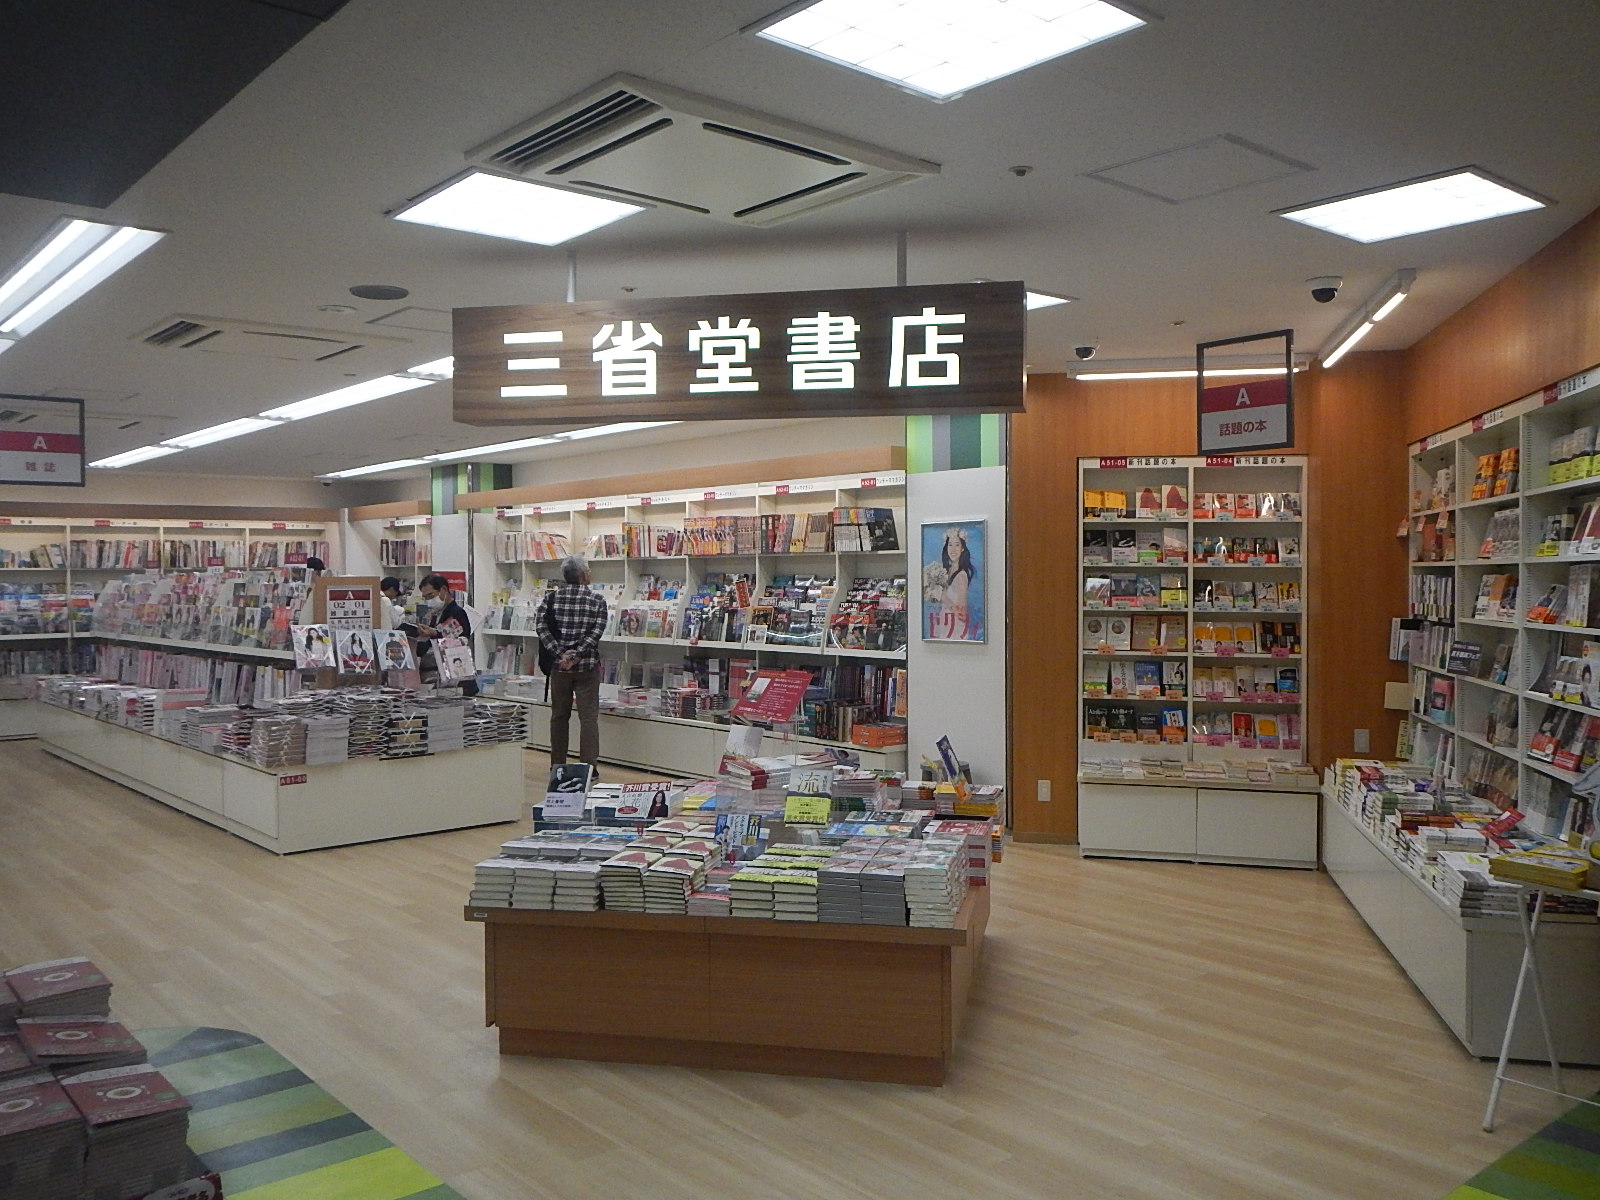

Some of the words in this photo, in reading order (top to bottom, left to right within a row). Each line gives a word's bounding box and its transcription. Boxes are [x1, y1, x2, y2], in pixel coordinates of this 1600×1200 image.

[500, 307, 966, 398] 三省堂書店
[1236, 388, 1251, 406] A
[1219, 420, 1267, 436] 話題の本
[33, 436, 48, 450] A
[345, 591, 354, 599] A
[797, 772, 820, 793] 流
